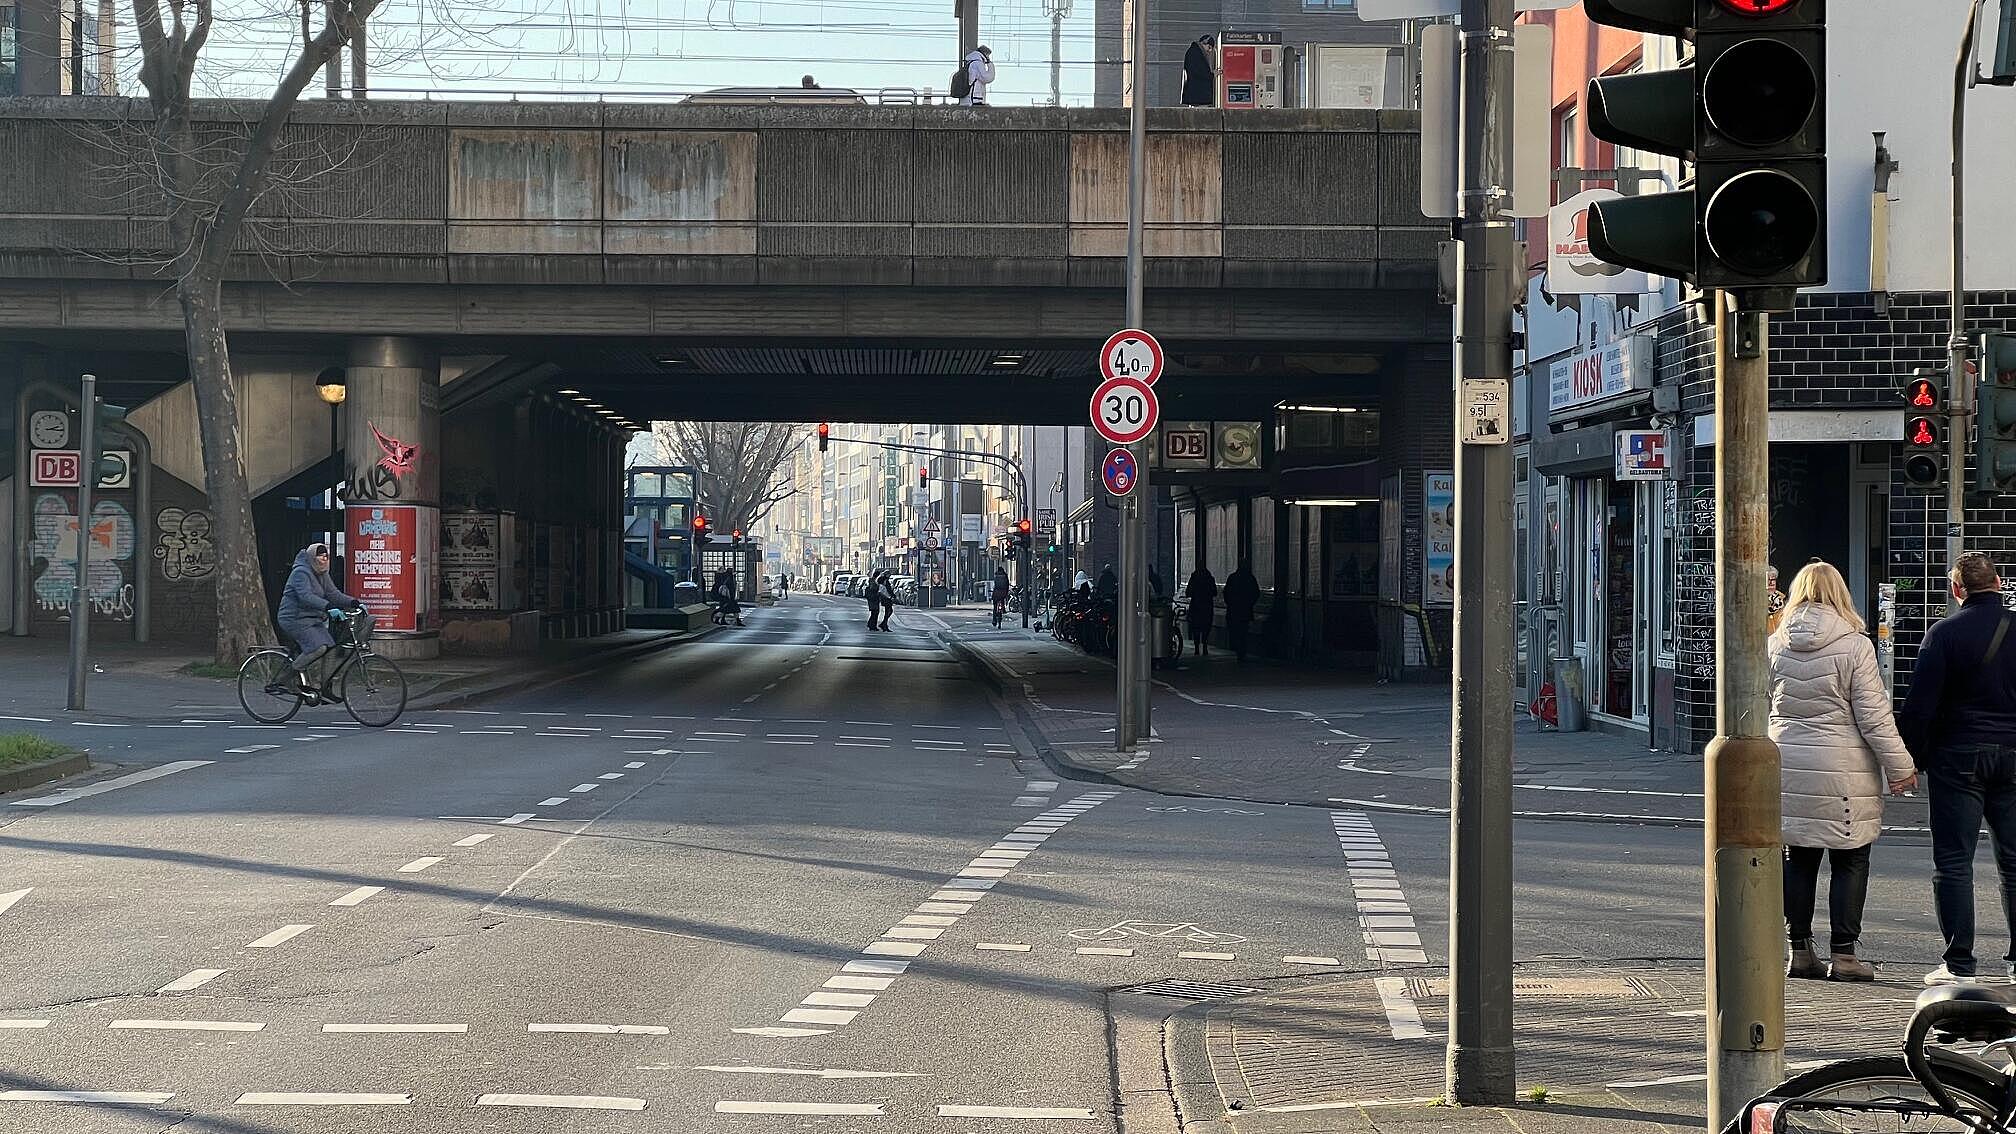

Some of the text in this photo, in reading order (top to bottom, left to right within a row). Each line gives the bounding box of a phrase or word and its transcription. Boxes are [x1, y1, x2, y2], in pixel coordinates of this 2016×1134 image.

[1573, 352, 1603, 399] KIOSK
[1105, 395, 1143, 425] 30
[1171, 435, 1203, 455] DB
[41, 457, 75, 479] DB
[355, 551, 401, 563] SMASHING
[355, 564, 401, 574] PUMPKINS
